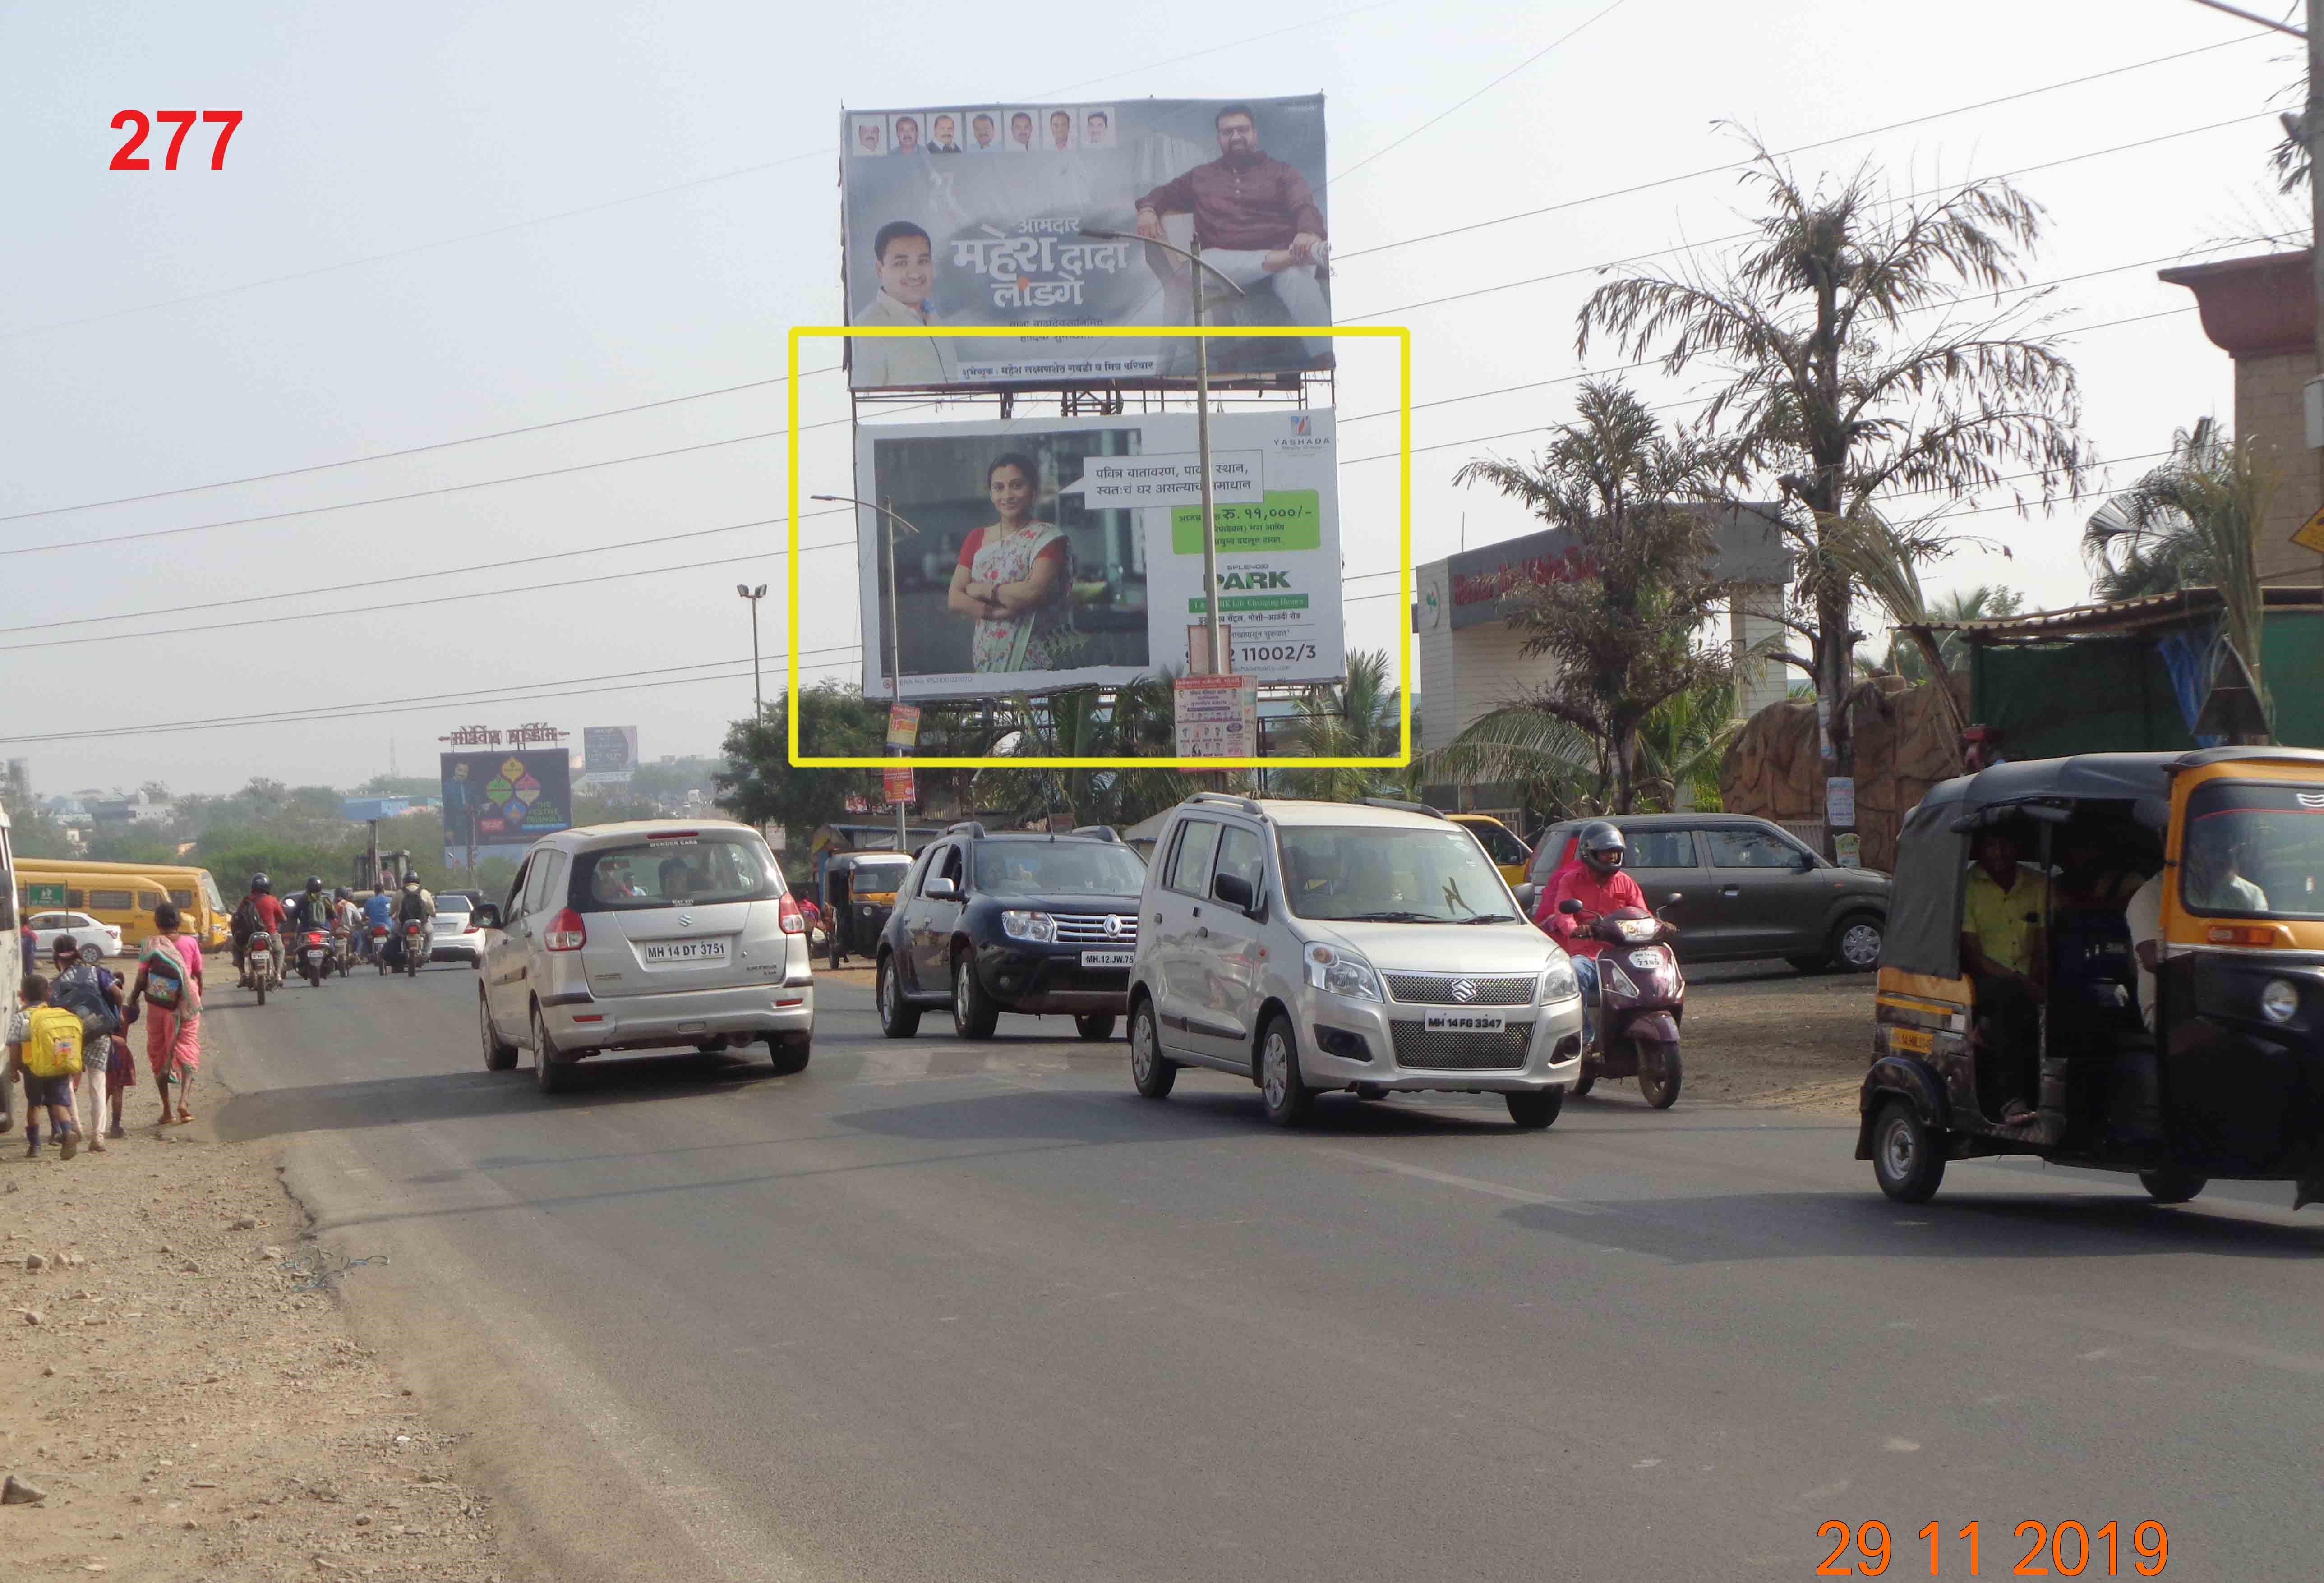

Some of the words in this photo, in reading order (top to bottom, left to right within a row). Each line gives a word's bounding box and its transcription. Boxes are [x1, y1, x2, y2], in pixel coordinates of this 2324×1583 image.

[1018, 217, 1081, 235] आमदार
[1057, 243, 1130, 274] दादा
[1001, 364, 1022, 376] महेश
[1124, 359, 1153, 370] परिवार
[1274, 437, 1330, 446] YASHADA
[1096, 466, 1122, 479] पवित्र
[1128, 466, 1179, 478] वातावरण,
[1184, 465, 1202, 476] पाव
[1216, 464, 1248, 475] स्थान,
[1137, 484, 1151, 495] घर
[1155, 482, 1202, 494] असल्याच
[1245, 505, 1312, 520] ११,०००/-
[1232, 599, 1245, 607] Life
[1247, 598, 1279, 607] Changing
[1242, 644, 1316, 662] 11002/3
[648, 947, 664, 957] MH
[668, 946, 680, 956] 14
[683, 945, 696, 955] DT
[701, 943, 725, 954] 3751
[1429, 1018, 1444, 1027] MH
[1447, 1018, 1457, 1027] 14
[1475, 1019, 1502, 1028] 3347
